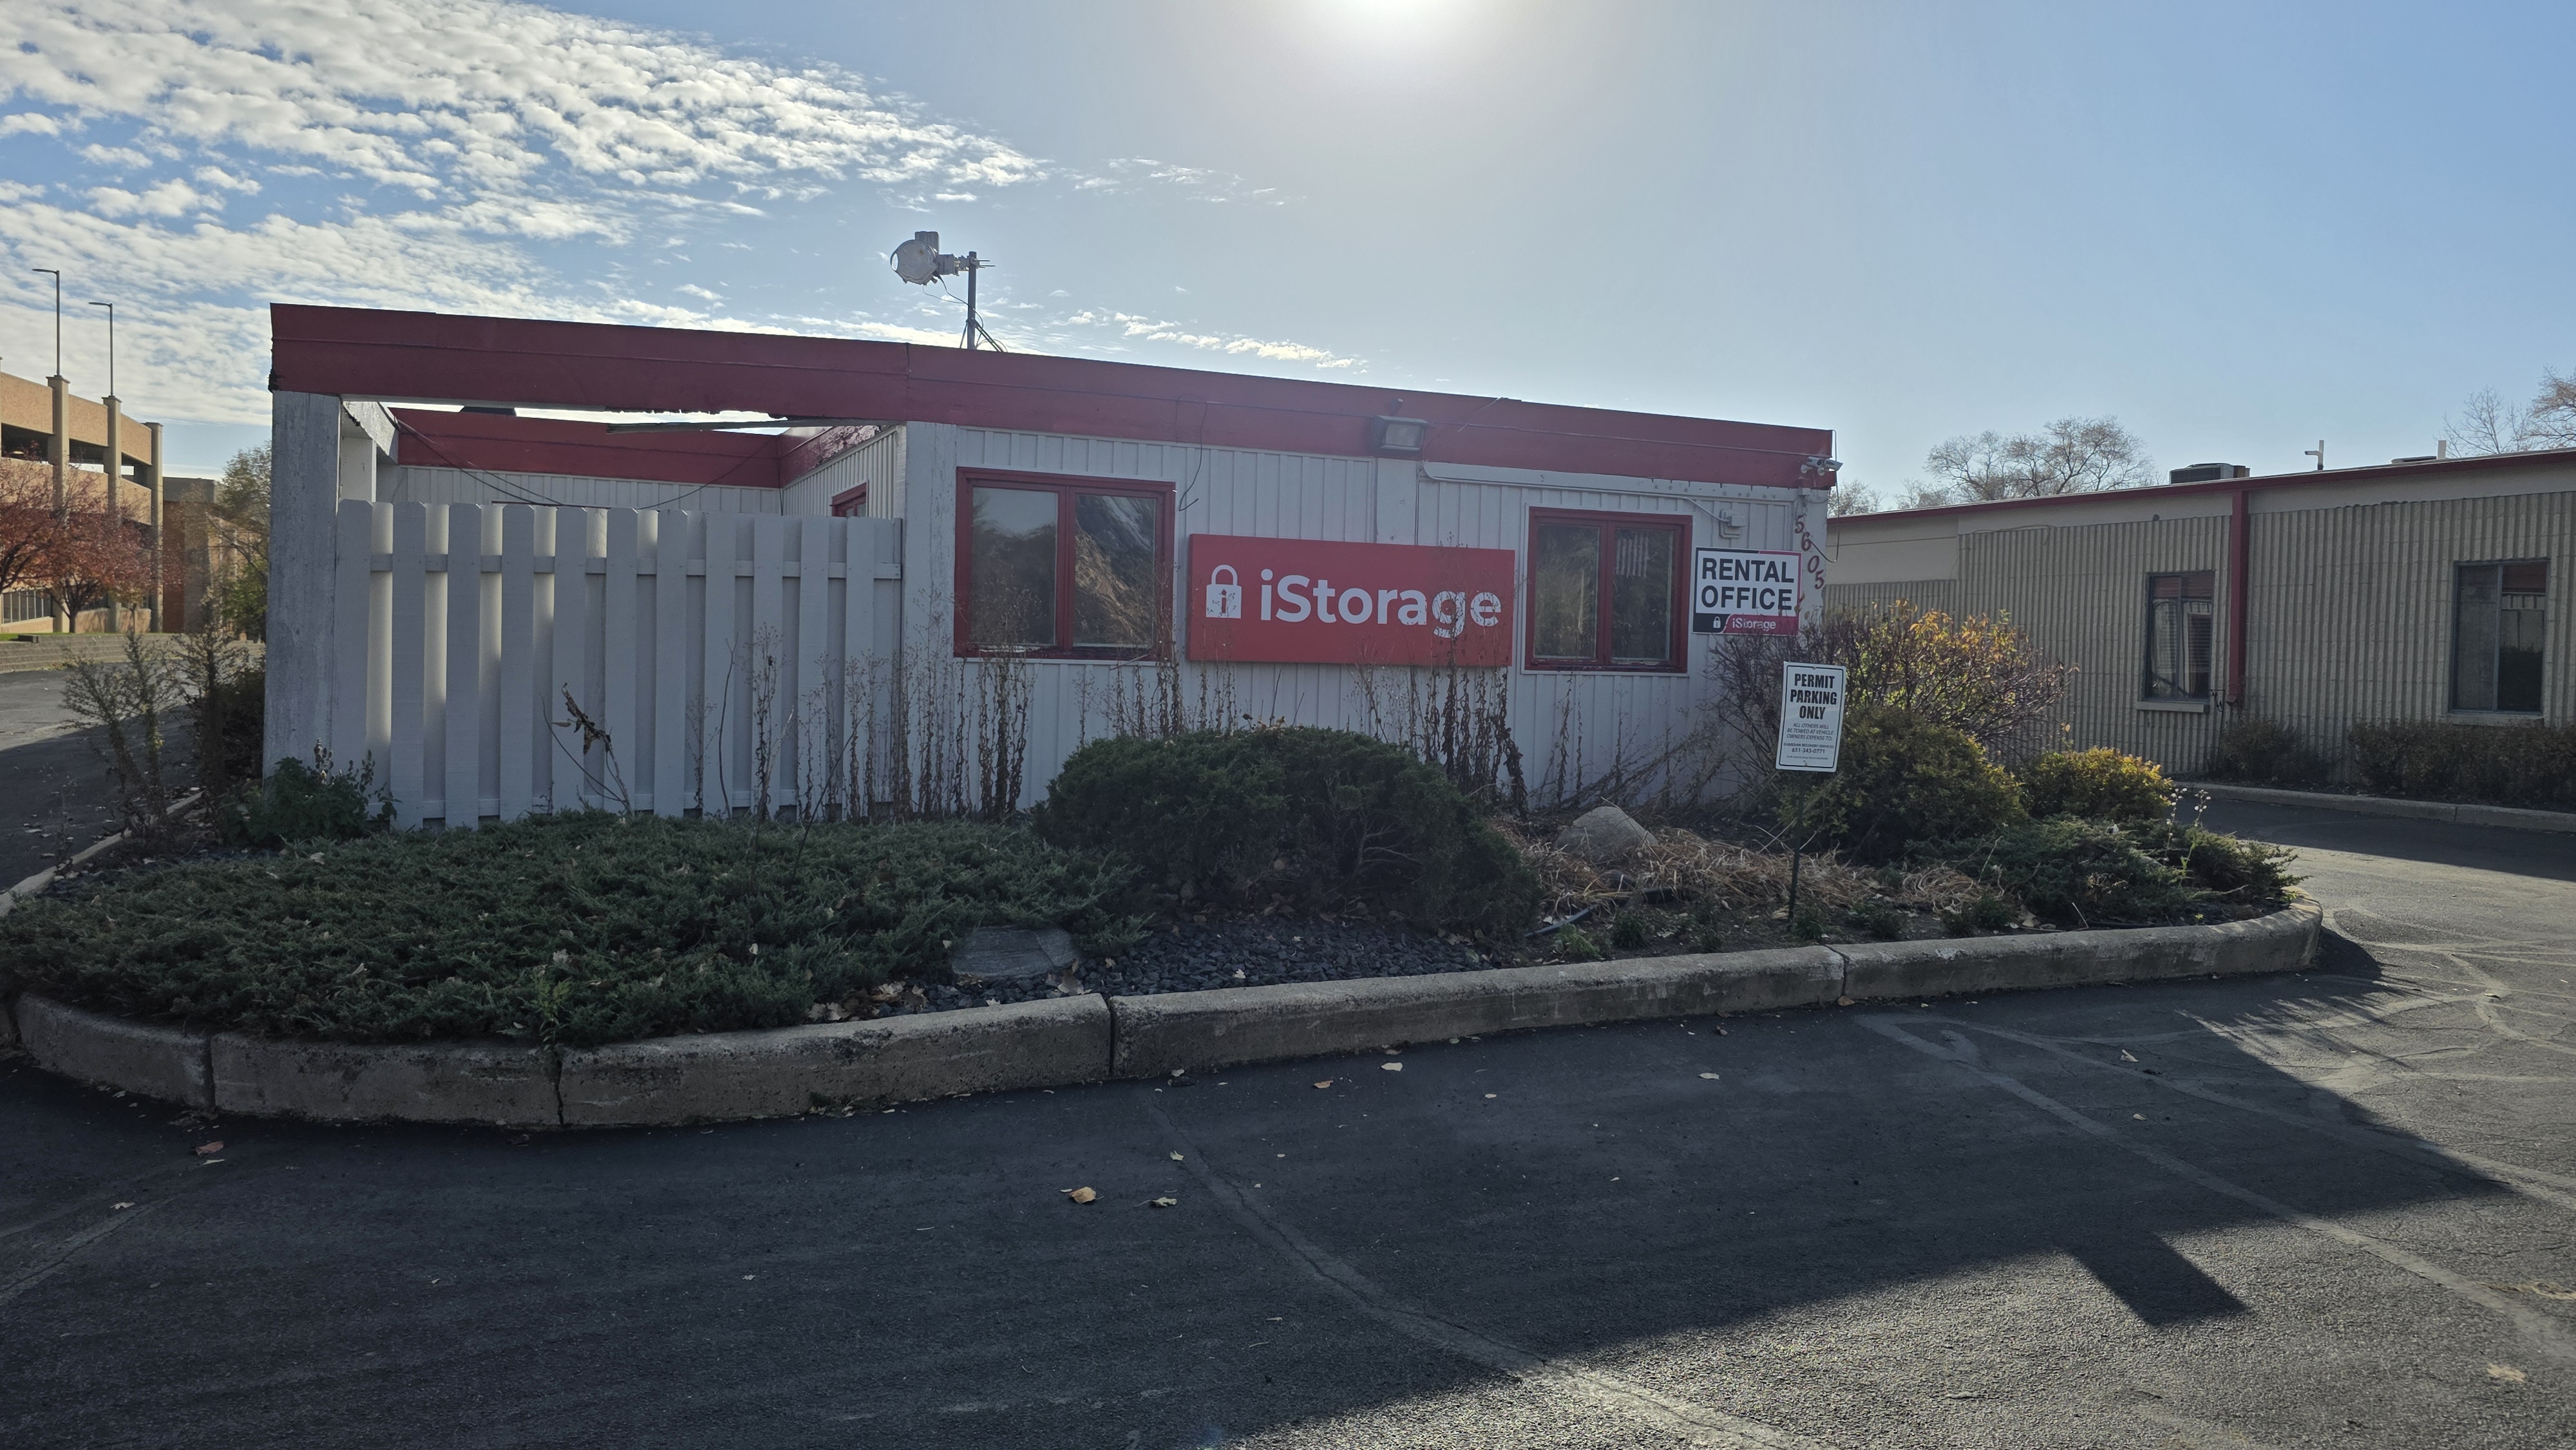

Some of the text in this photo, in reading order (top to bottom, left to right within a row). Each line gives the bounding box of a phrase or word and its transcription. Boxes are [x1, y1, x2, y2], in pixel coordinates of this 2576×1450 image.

[1794, 514, 1824, 590] 5605
[1702, 557, 1794, 583] RENTAL
[1260, 569, 1502, 639] iStorage
[1701, 585, 1792, 610] OFFICE
[1732, 617, 1776, 632] iStorage
[1794, 673, 1835, 688] PERMIT
[1790, 689, 1837, 705] PARKING
[1799, 705, 1826, 719] ONLY
